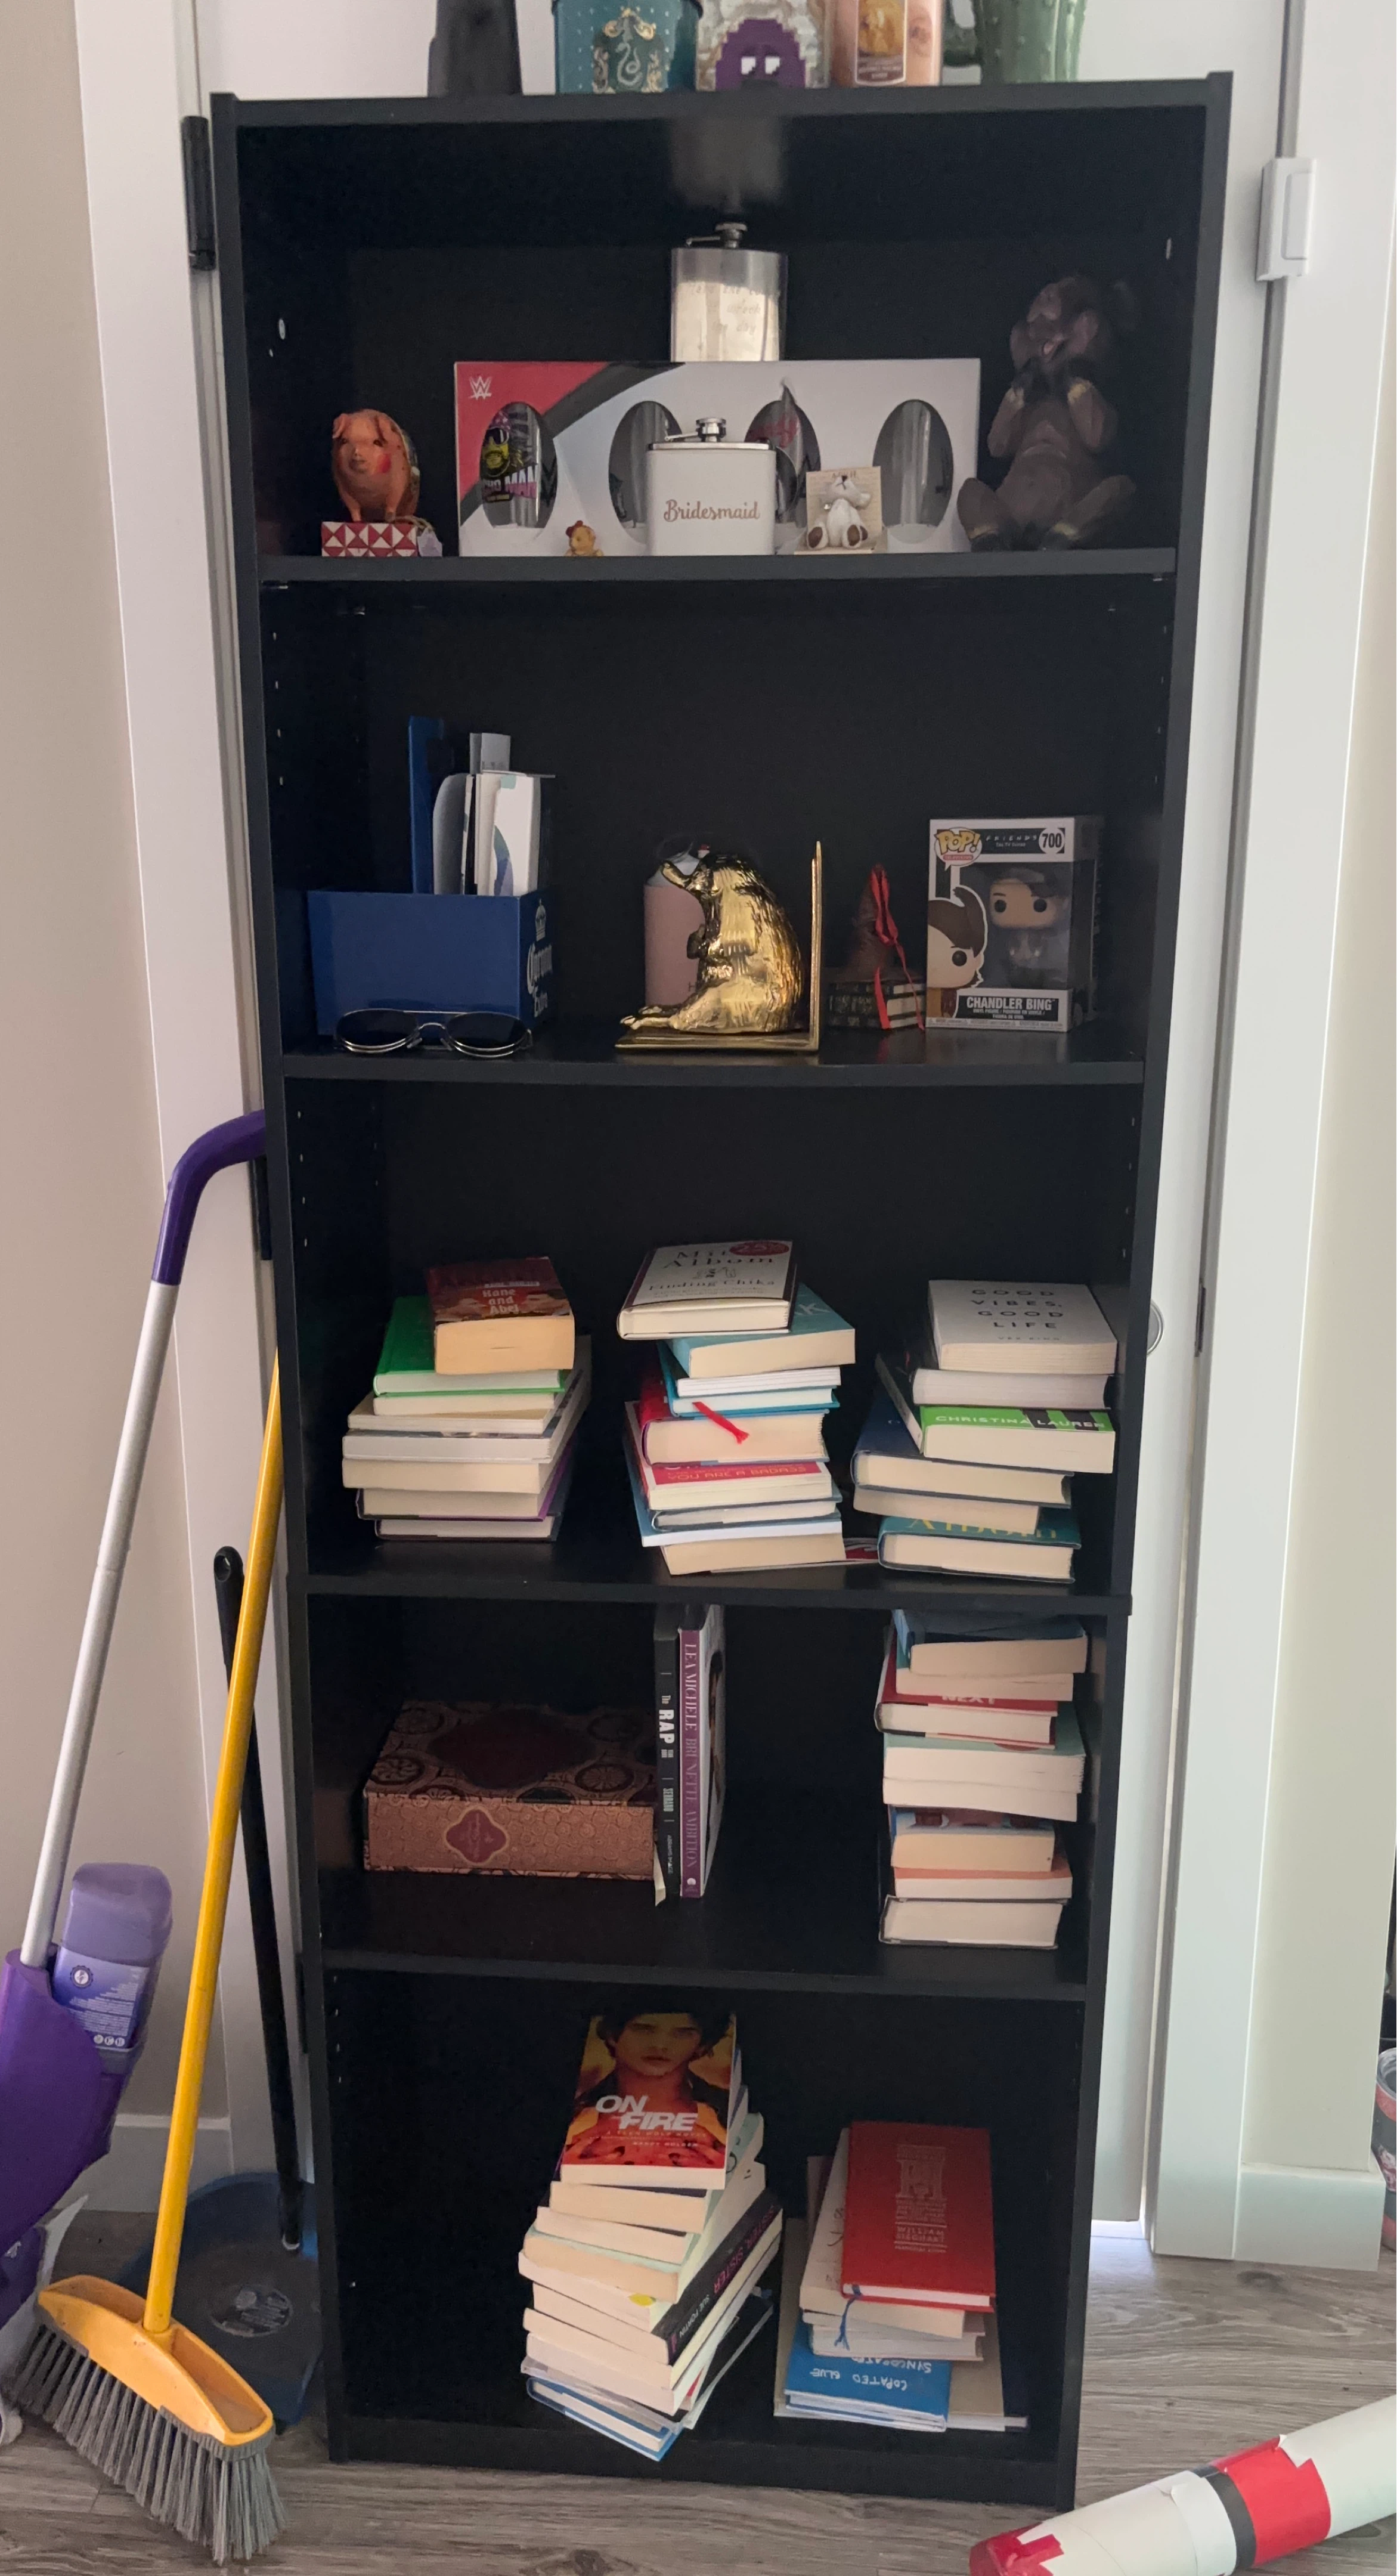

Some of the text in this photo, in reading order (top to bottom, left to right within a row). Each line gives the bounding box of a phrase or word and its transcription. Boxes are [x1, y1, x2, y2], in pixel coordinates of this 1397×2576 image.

[664, 499, 761, 522] Bridesmaid
[934, 829, 981, 855] POP!
[1042, 833, 1062, 848] 700
[967, 996, 1052, 1011] CHANDLER BING
[664, 1258, 773, 1268] Albom
[482, 1288, 516, 1298] Kane
[489, 1296, 514, 1305] and
[490, 1304, 519, 1316] Abel
[936, 1415, 1105, 1428] CHRISTINA LAUREN
[751, 1466, 806, 1476] BADASS
[659, 1709, 676, 1744] RAP
[685, 1644, 698, 1868] LEA MICHELE BRUNETTE AMBITION
[663, 1788, 674, 1812] SERRANO
[595, 2094, 649, 2116] ON
[618, 2111, 698, 2131] FIRE
[714, 2246, 744, 2294] SISTER
[699, 2294, 710, 2311] SUE
[679, 2311, 699, 2339] FORTIN
[851, 2356, 932, 2374] SYNCOPAT
